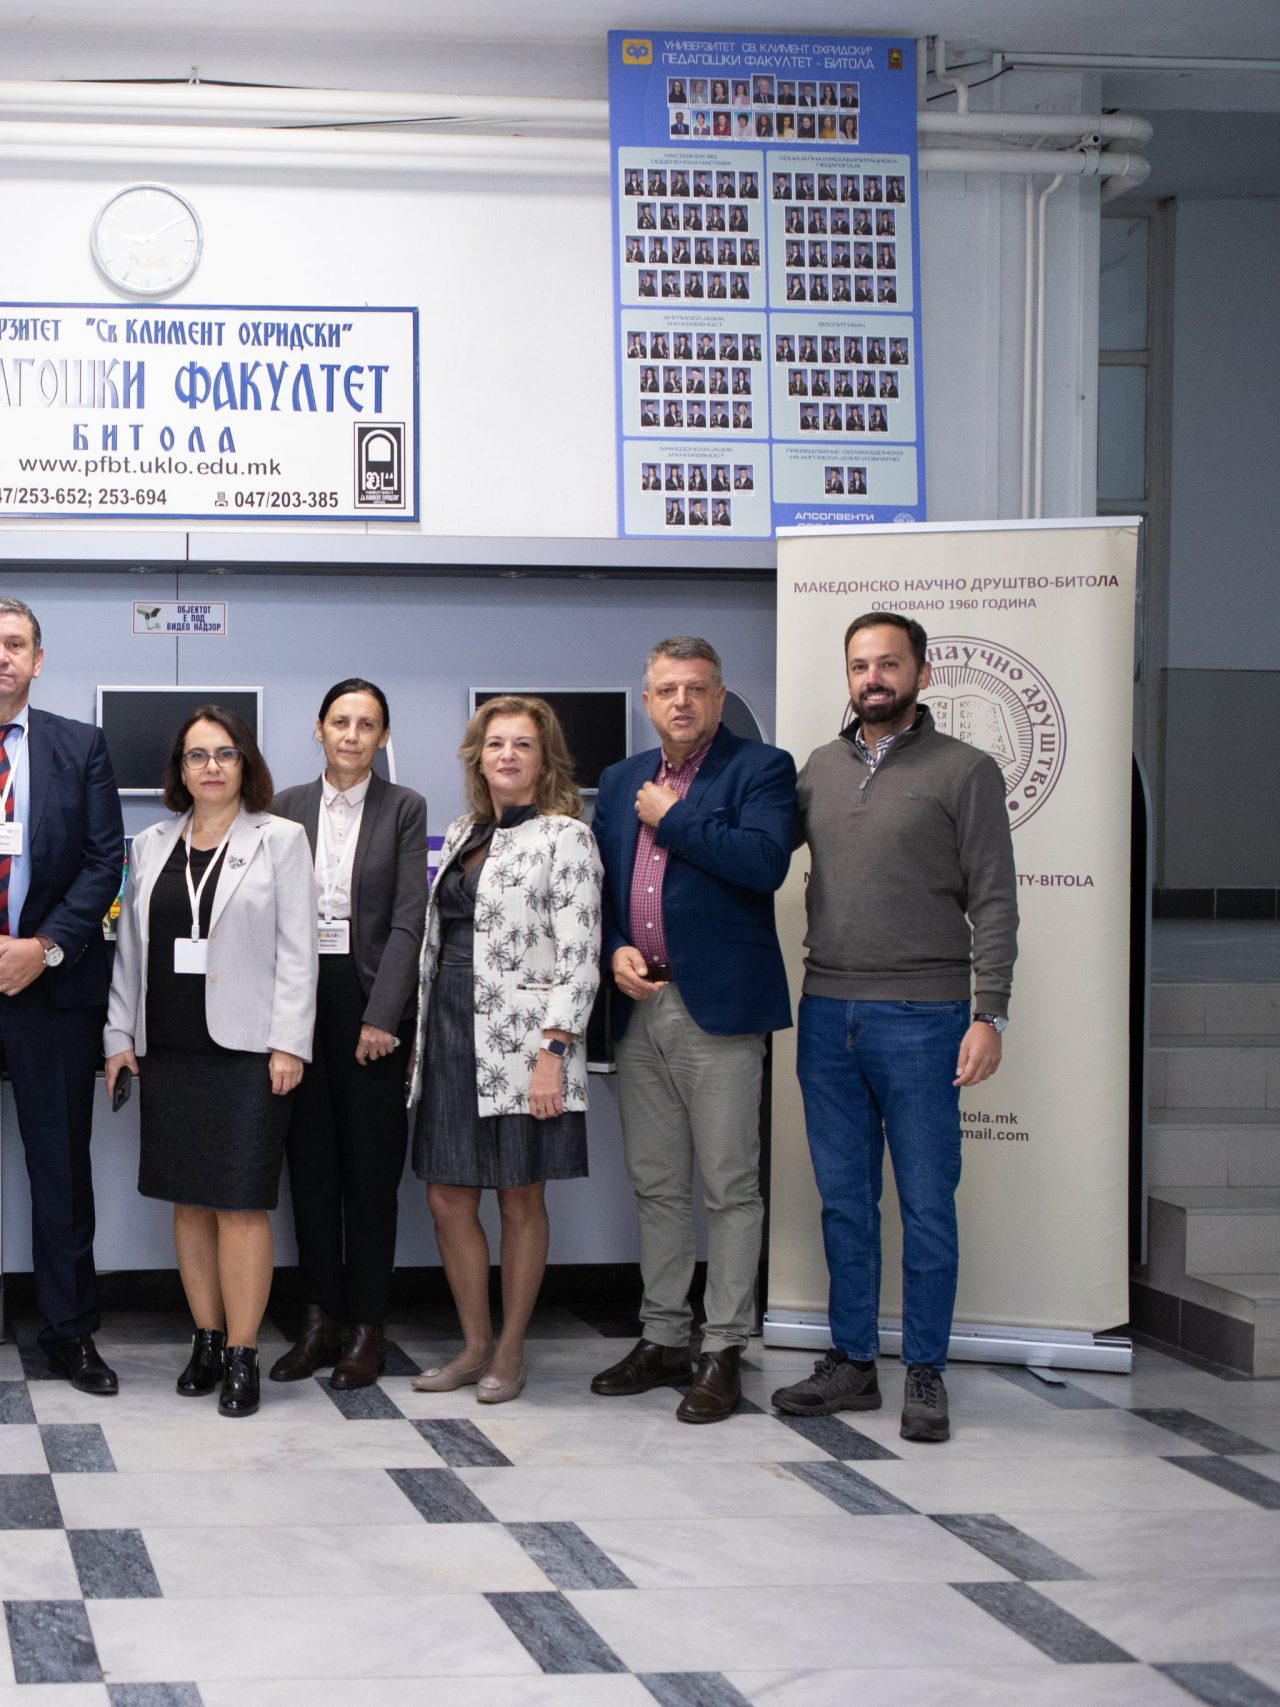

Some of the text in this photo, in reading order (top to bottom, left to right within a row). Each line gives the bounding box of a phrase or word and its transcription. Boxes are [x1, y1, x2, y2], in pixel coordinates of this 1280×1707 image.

[664, 40, 735, 52] УНИВЕРЗИТЕТ
[759, 43, 809, 55] КЛИМЕНТ
[662, 52, 740, 66] ПЕДАГОШКИ
[744, 55, 813, 68] ФАКУЛТЕТ
[824, 57, 875, 70] БИТОЛА
[126, 319, 225, 347] КЛИМЕНТ
[174, 360, 389, 414] ФАКУЛТЕТ
[72, 424, 236, 454] БИТОЛА
[18, 455, 282, 478] www.pfbt.uklo.edu.mk
[98, 488, 167, 506] 253-694
[234, 490, 339, 510] 047/203-385
[794, 512, 874, 521] АПСОЛВЕНТИ
[793, 575, 1119, 595] МАКЕДОНСКО НАУЧНО ДРУШТВО-БИТОЛА
[177, 605, 211, 614] ОБЈЕКТОТ
[871, 597, 1037, 611] ОСНОВАНО 1960 ГОДИНА
[166, 622, 221, 632] ВИДЕО НАДЗОР
[183, 614, 205, 622] Е ПОД
